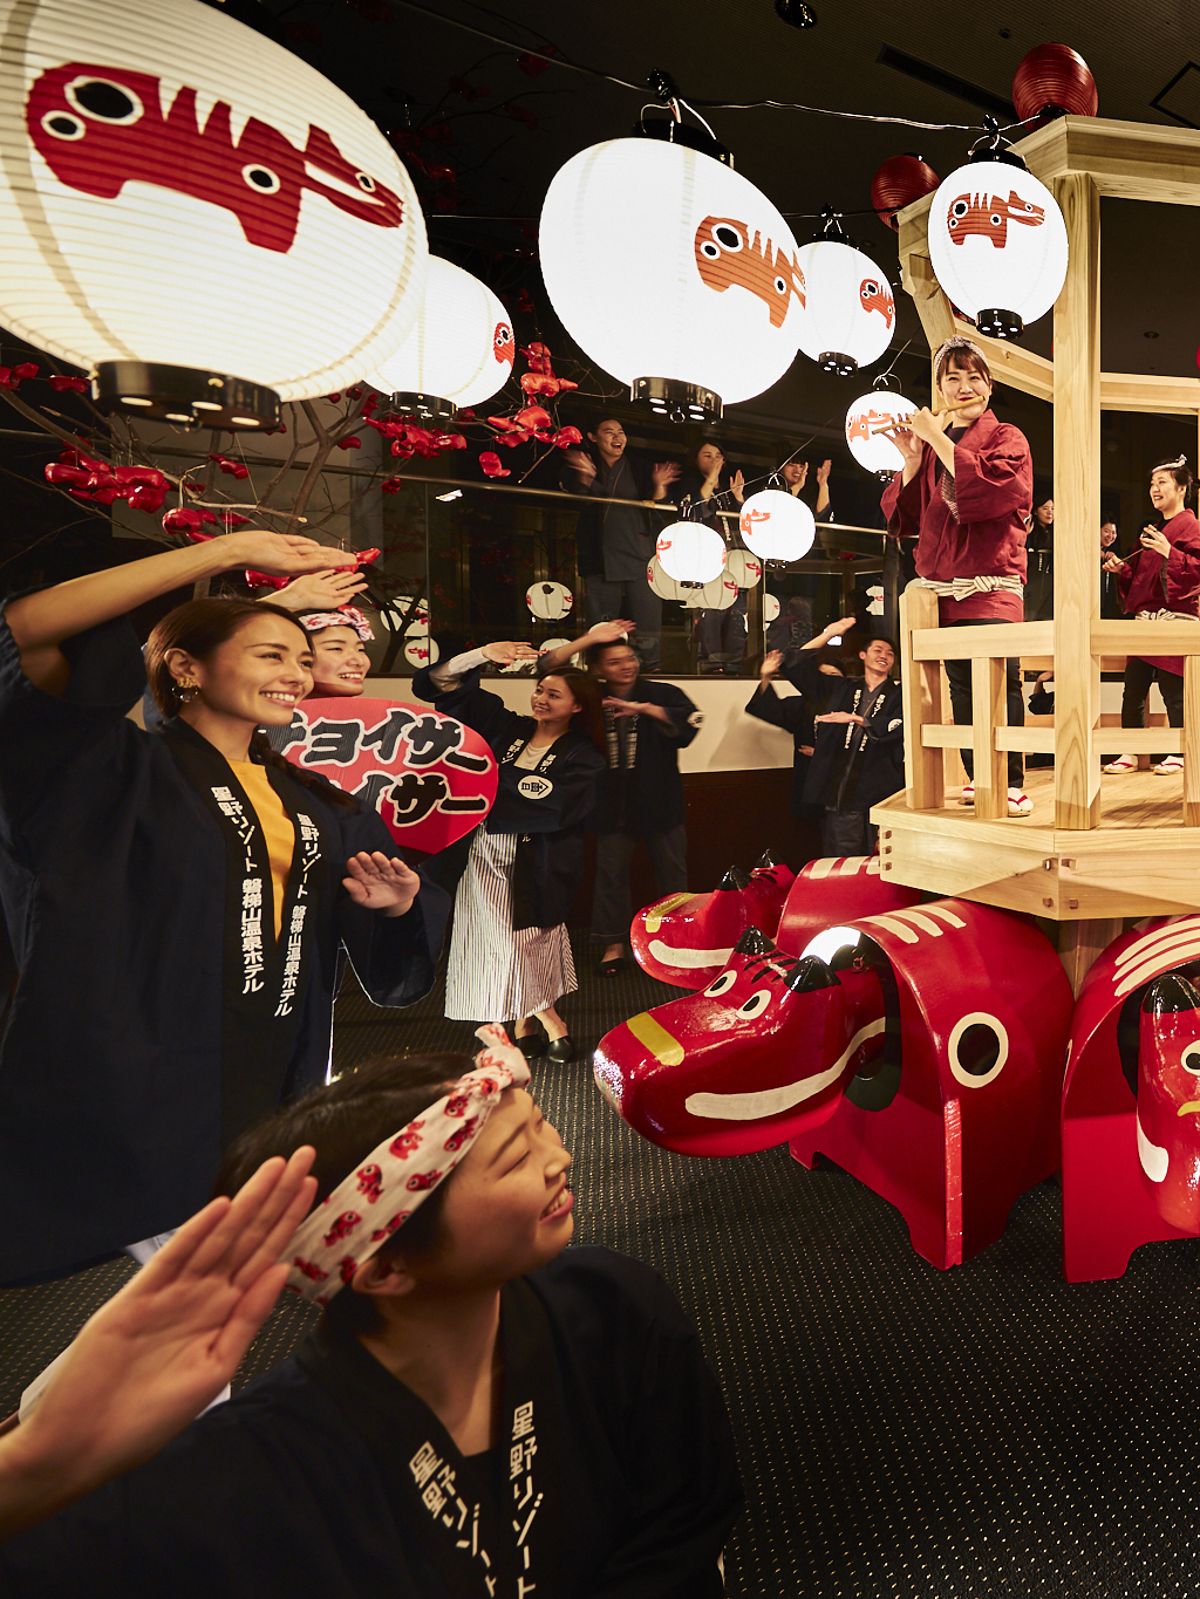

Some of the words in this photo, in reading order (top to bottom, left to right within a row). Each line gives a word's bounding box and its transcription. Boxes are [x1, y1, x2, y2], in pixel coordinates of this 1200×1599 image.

[211, 786, 258, 872] 星野リゾート
[296, 812, 322, 899] 星野リゾート
[408, 1440, 497, 1598] 星野リゾート
[508, 1400, 544, 1599] 星野リゾート
